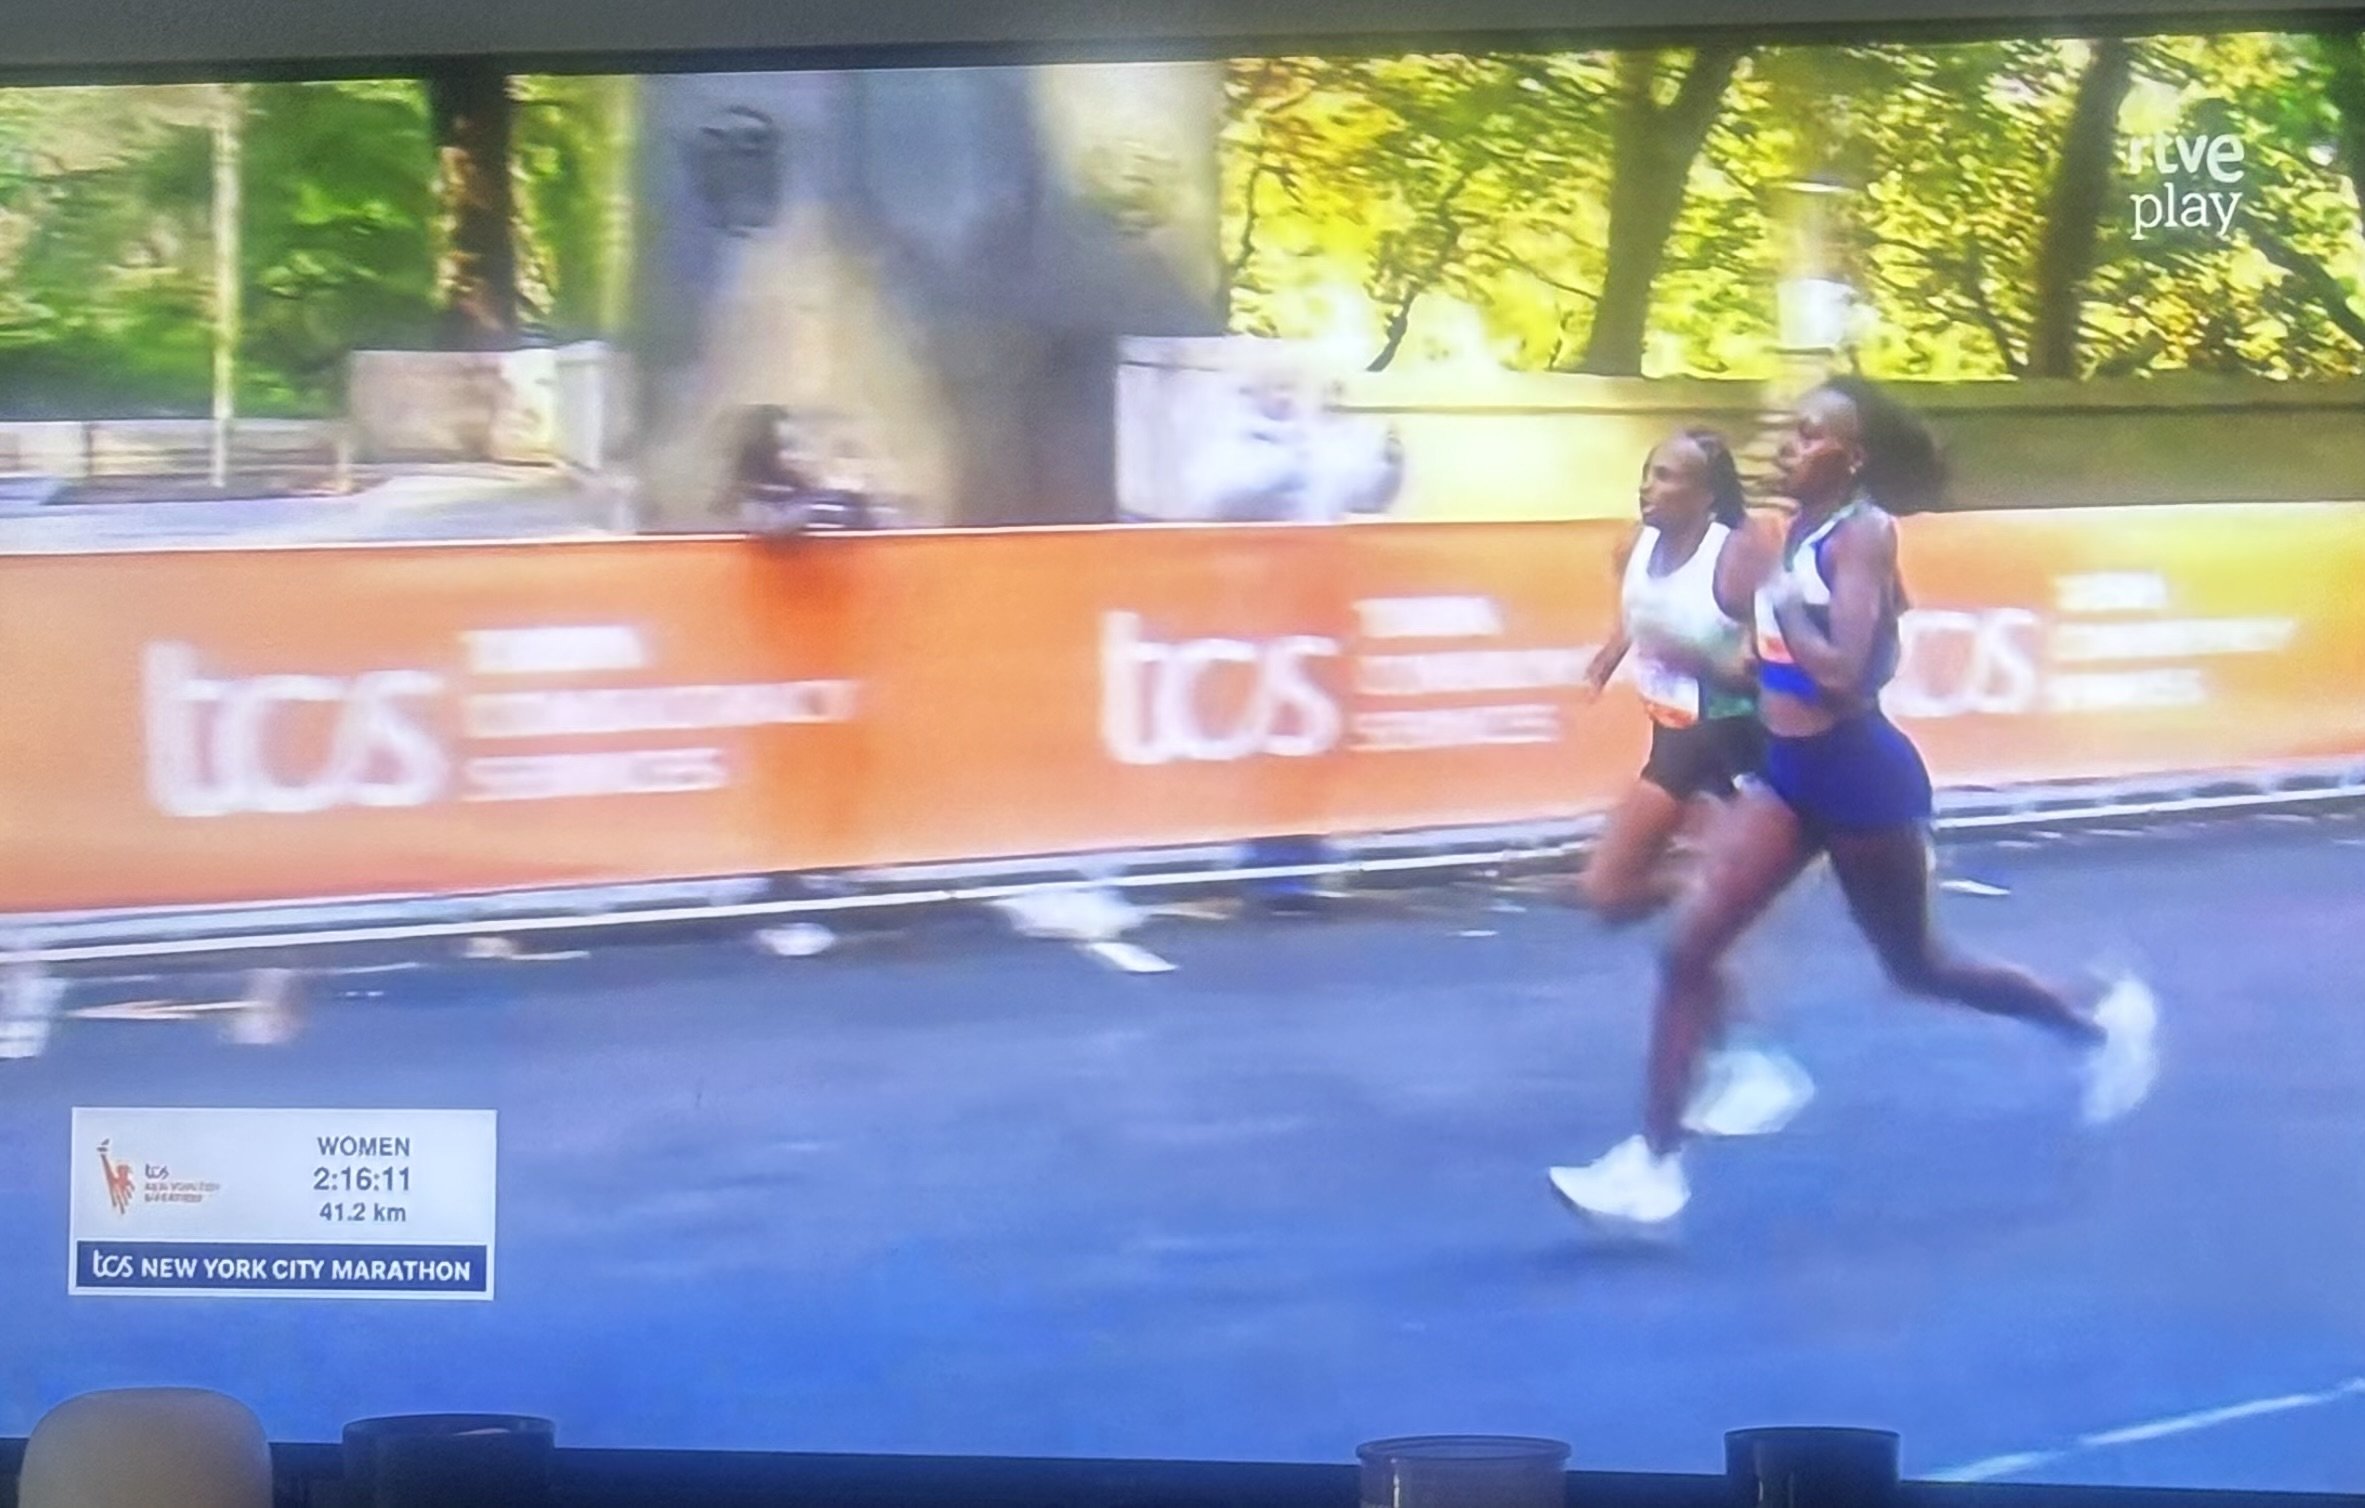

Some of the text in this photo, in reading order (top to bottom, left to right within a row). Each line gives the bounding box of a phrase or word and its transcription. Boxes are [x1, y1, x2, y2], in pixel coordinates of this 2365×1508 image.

[2128, 131, 2245, 183] rtve
[2129, 182, 2243, 240] play
[1104, 610, 1341, 764] tcs
[1880, 608, 2037, 718] cs
[143, 640, 450, 816] tcs
[317, 1136, 411, 1158] WOMEN
[313, 1167, 411, 1191] 2:16:11
[319, 1203, 407, 1222] 41.2 km
[93, 1249, 471, 1281] tcs NEW YORK CITY MARATHON
